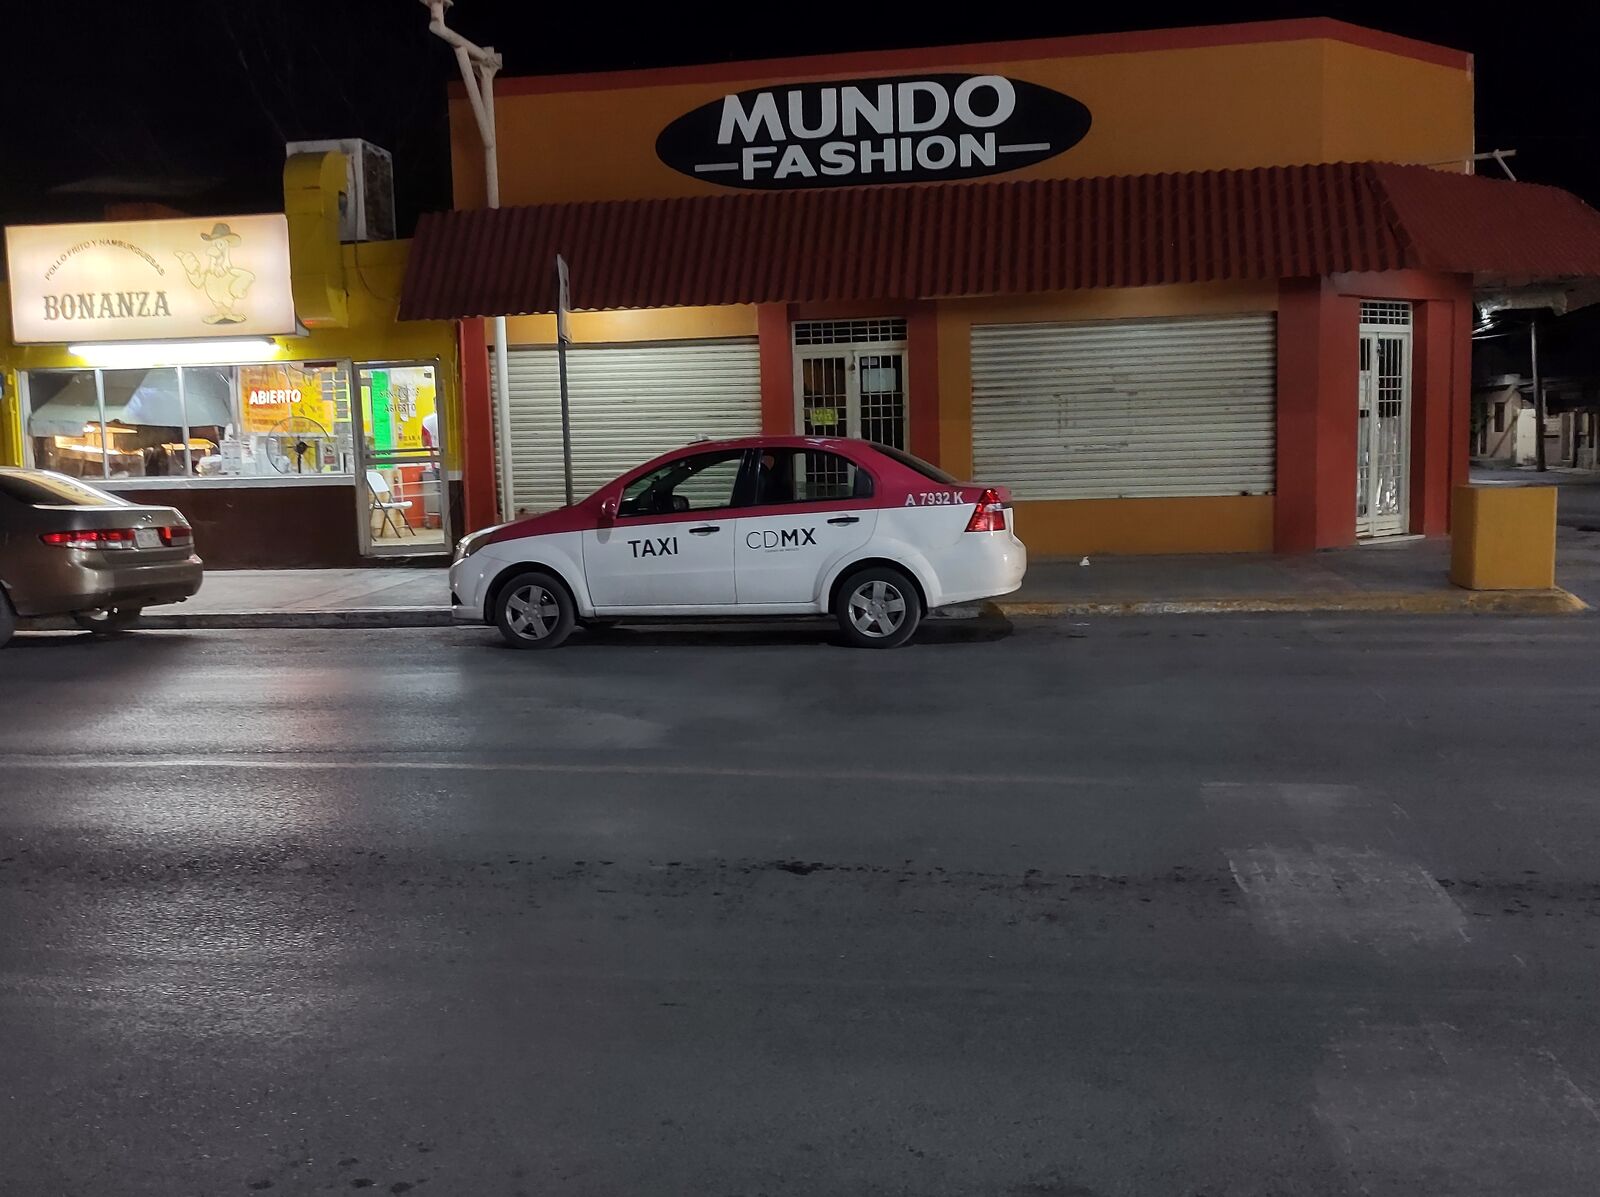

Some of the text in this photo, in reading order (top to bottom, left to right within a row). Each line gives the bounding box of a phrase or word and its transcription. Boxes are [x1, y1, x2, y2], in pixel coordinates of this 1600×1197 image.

[717, 75, 1016, 145] MUNDO
[741, 132, 997, 181] FASHION
[45, 254, 67, 281] POLLO
[67, 241, 90, 257] FRITO
[91, 239, 97, 248] Y
[43, 290, 172, 321] BONANZA
[249, 389, 302, 406] ABIERTO
[905, 491, 964, 506] A 7932 K
[628, 536, 678, 559] TAXI
[746, 527, 817, 549] CDMX
